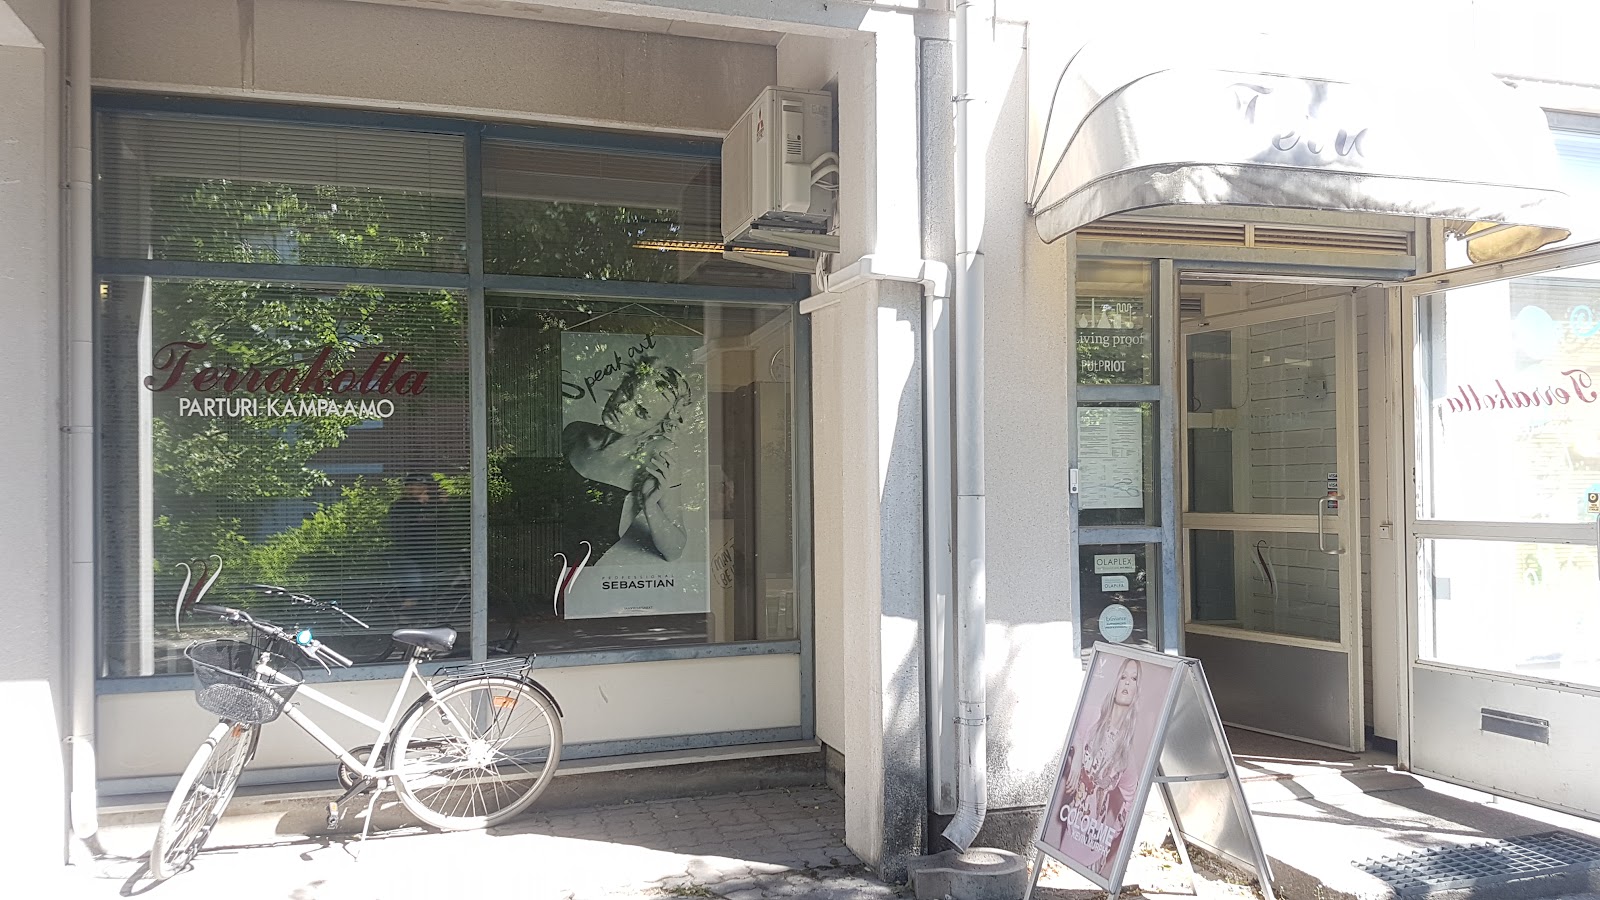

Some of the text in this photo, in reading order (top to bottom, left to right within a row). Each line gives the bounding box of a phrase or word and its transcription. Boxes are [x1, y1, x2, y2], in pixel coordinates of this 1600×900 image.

[1112, 333, 1144, 348] proof
[561, 332, 657, 404] Speak out
[1096, 558, 1132, 566] OLAPLEX
[602, 579, 674, 590] SEBASTIAN
